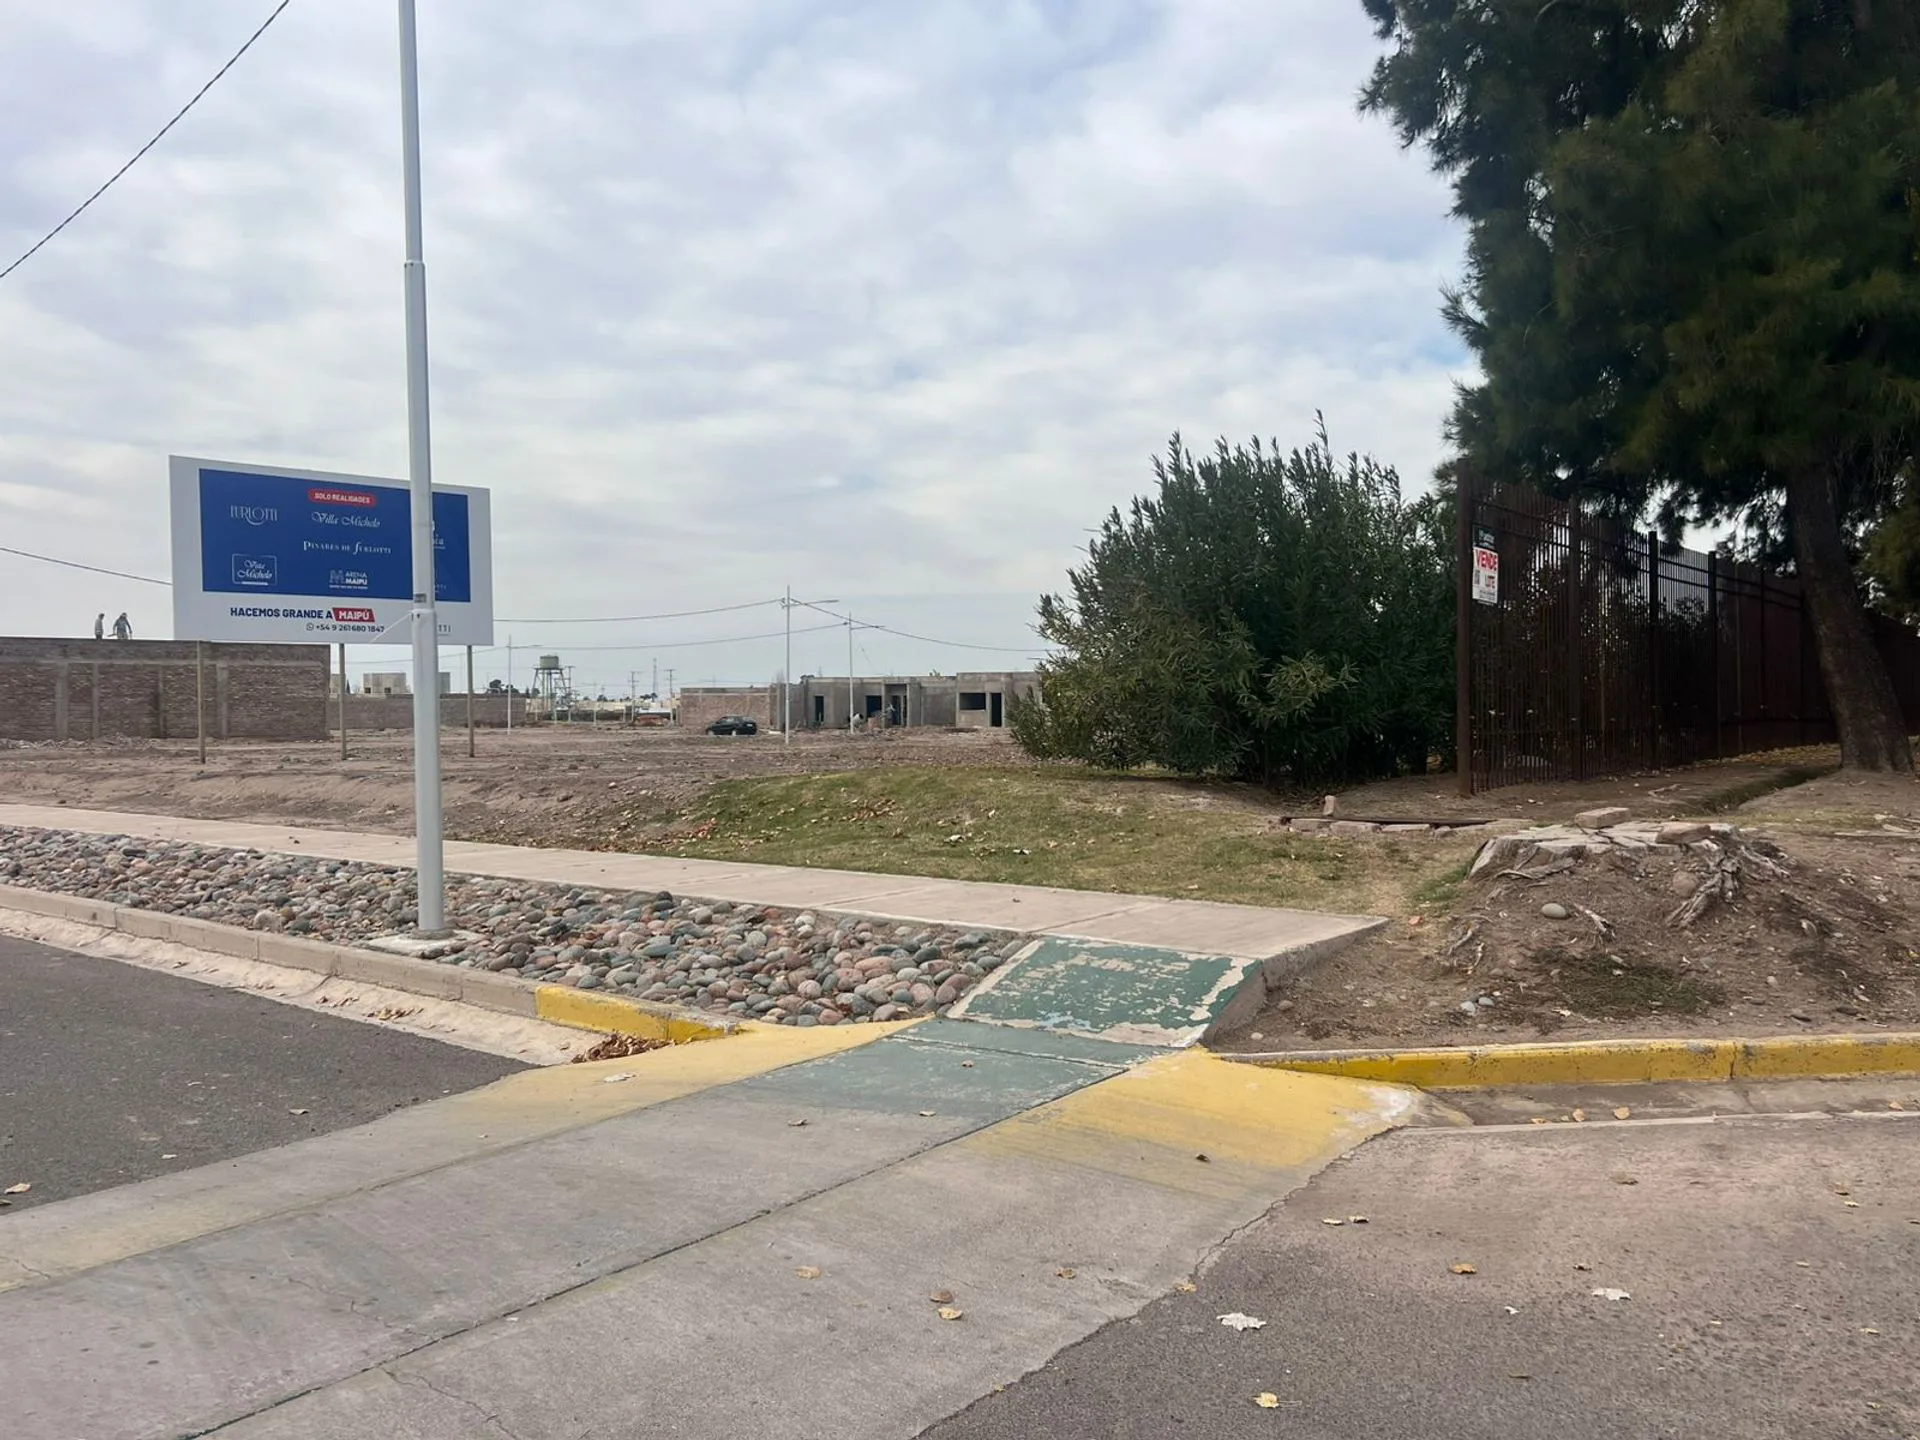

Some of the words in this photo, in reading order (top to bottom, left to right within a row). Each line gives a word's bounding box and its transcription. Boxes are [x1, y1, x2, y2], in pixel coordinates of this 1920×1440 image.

[314, 492, 332, 501] SOLO
[332, 494, 371, 504] REALIDADES
[311, 511, 339, 525] Villa
[1475, 549, 1498, 571] VENDE
[230, 607, 280, 618] HACEMOS
[282, 608, 324, 619] GRANDE
[325, 611, 333, 619] A
[338, 609, 370, 621] MAIPÚ
[315, 622, 330, 631] +54
[331, 623, 338, 631] 9
[367, 625, 385, 633] 1847
